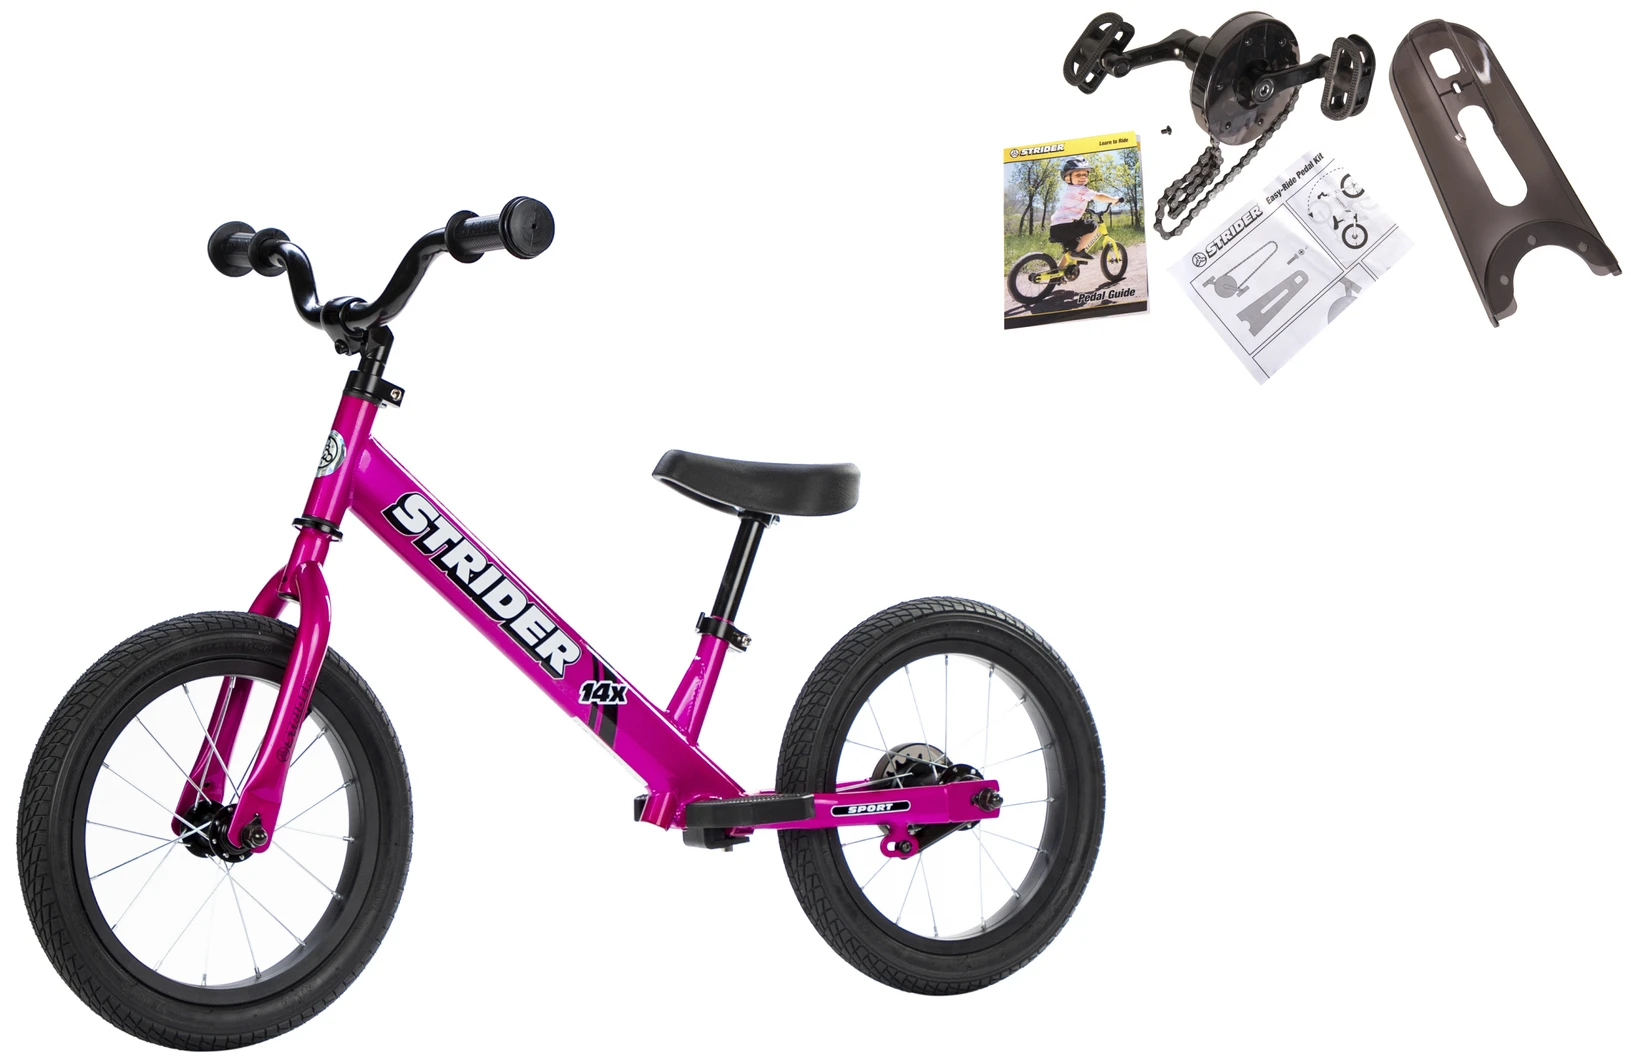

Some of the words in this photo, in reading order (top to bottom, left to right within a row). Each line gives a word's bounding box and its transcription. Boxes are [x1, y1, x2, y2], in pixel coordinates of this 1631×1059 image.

[1020, 144, 1065, 156] STRIDER
[1265, 176, 1298, 205] Easy-Ride
[1295, 160, 1315, 180] Pedal
[1312, 152, 1325, 165] Kit
[1205, 205, 1263, 258] STRIDER
[1078, 290, 1106, 303] Pedal
[1108, 287, 1136, 300] Guide
[381, 492, 582, 679] STRIDER
[847, 803, 894, 814] SPORT
